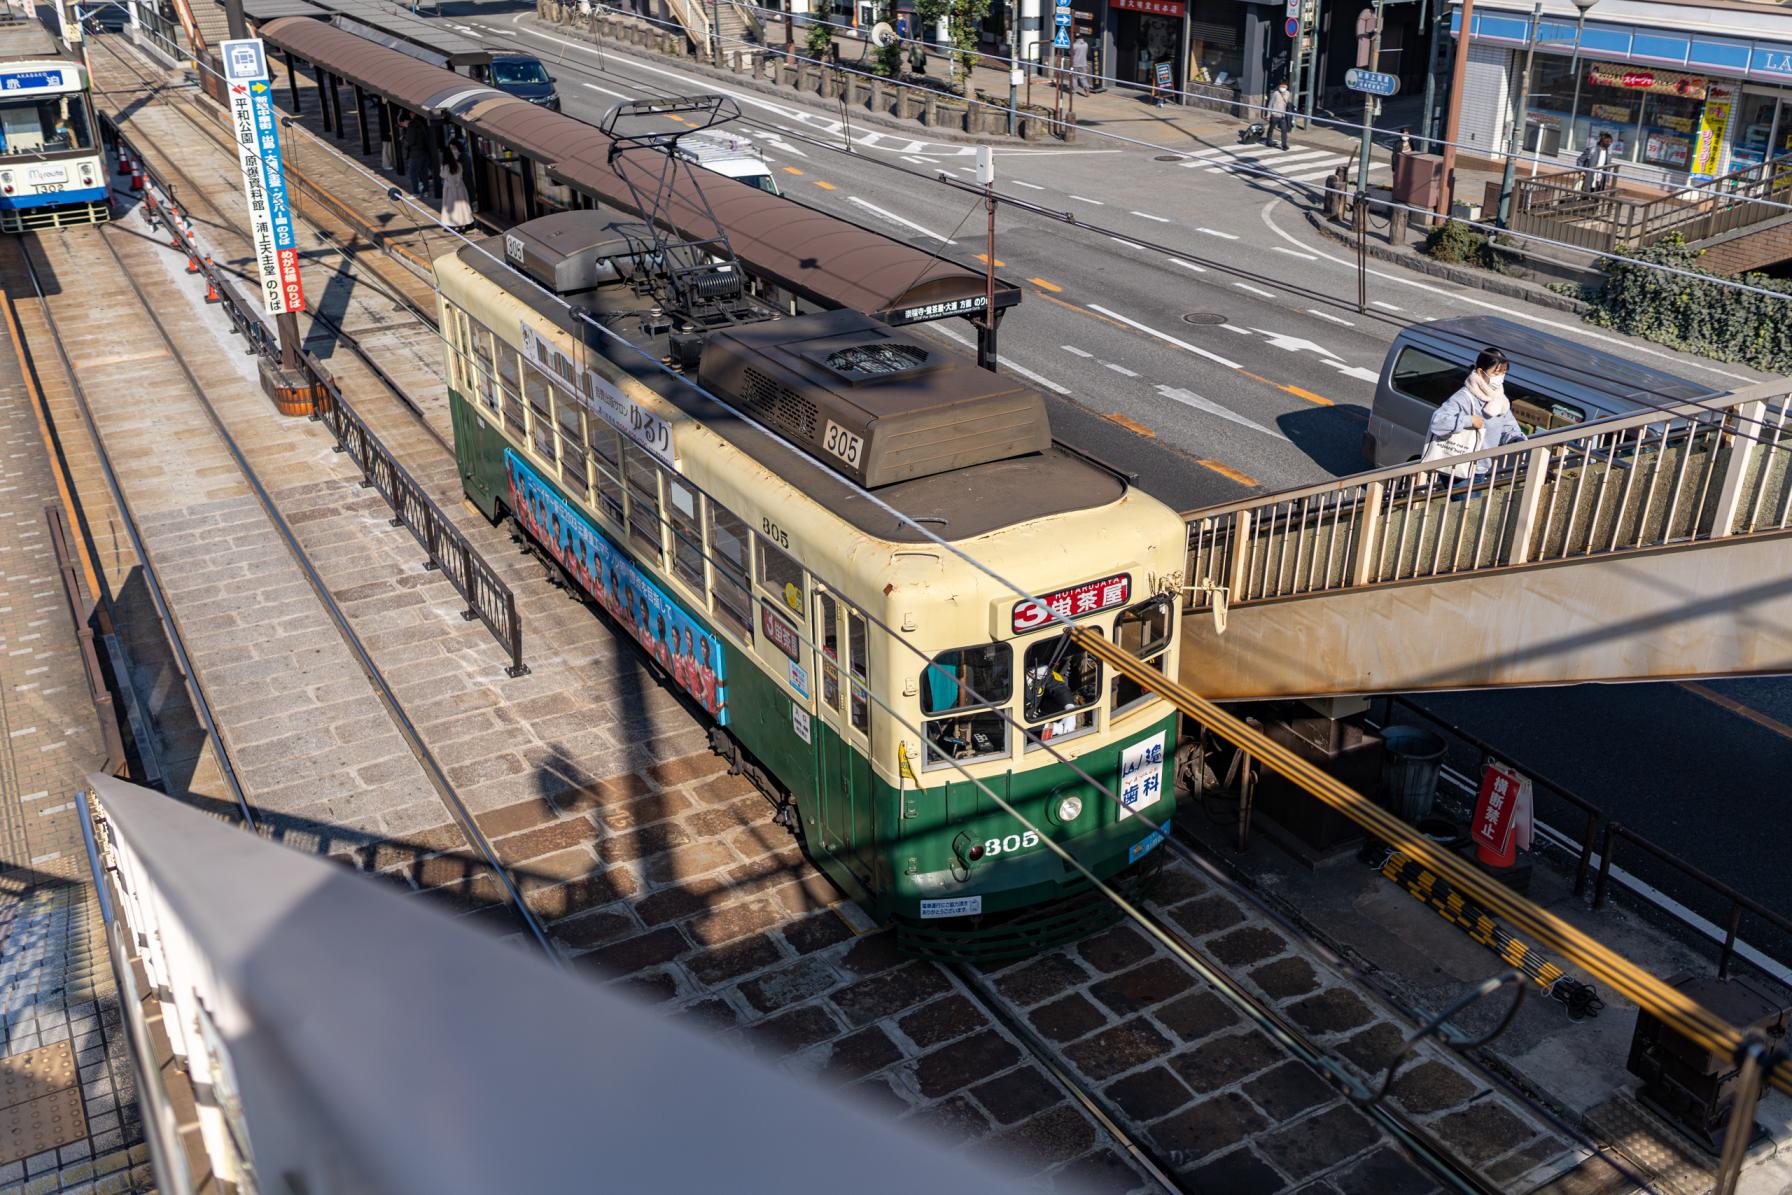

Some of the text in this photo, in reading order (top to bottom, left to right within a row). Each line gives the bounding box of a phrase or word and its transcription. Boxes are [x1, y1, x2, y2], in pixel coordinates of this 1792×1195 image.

[1764, 53, 1792, 71] LA
[507, 238, 523, 260] 305
[267, 279, 282, 311] のりば
[286, 284, 302, 309] のりば
[630, 405, 670, 451] ゆるり
[828, 426, 859, 463] 305
[762, 517, 789, 549] 305
[1123, 772, 1160, 807] 歯科
[1481, 776, 1510, 840] 横断禁止
[985, 830, 1039, 857] 305
